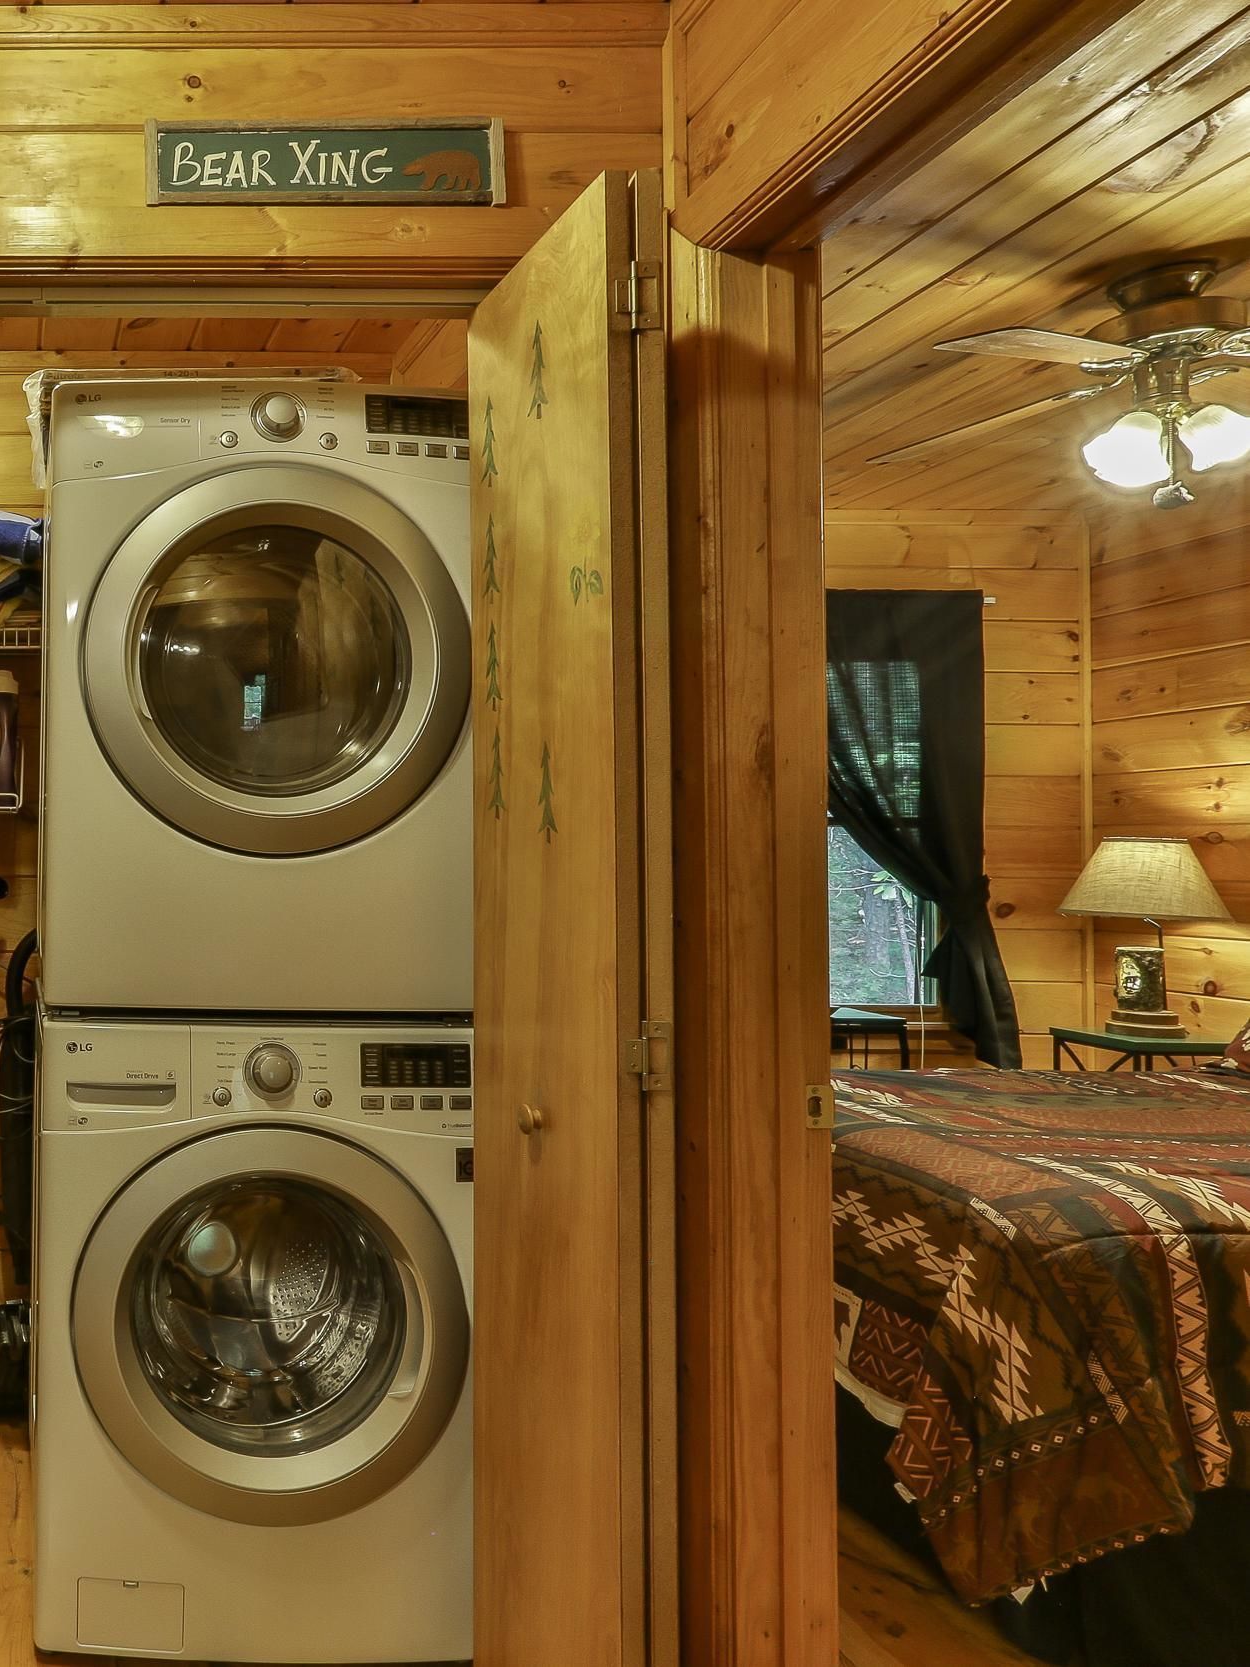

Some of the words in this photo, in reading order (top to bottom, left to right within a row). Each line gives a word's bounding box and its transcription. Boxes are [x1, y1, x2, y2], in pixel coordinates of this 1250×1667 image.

[168, 141, 278, 188] BEAR
[288, 139, 394, 187] XING
[180, 417, 191, 425] Dry
[79, 1043, 93, 1052] LG
